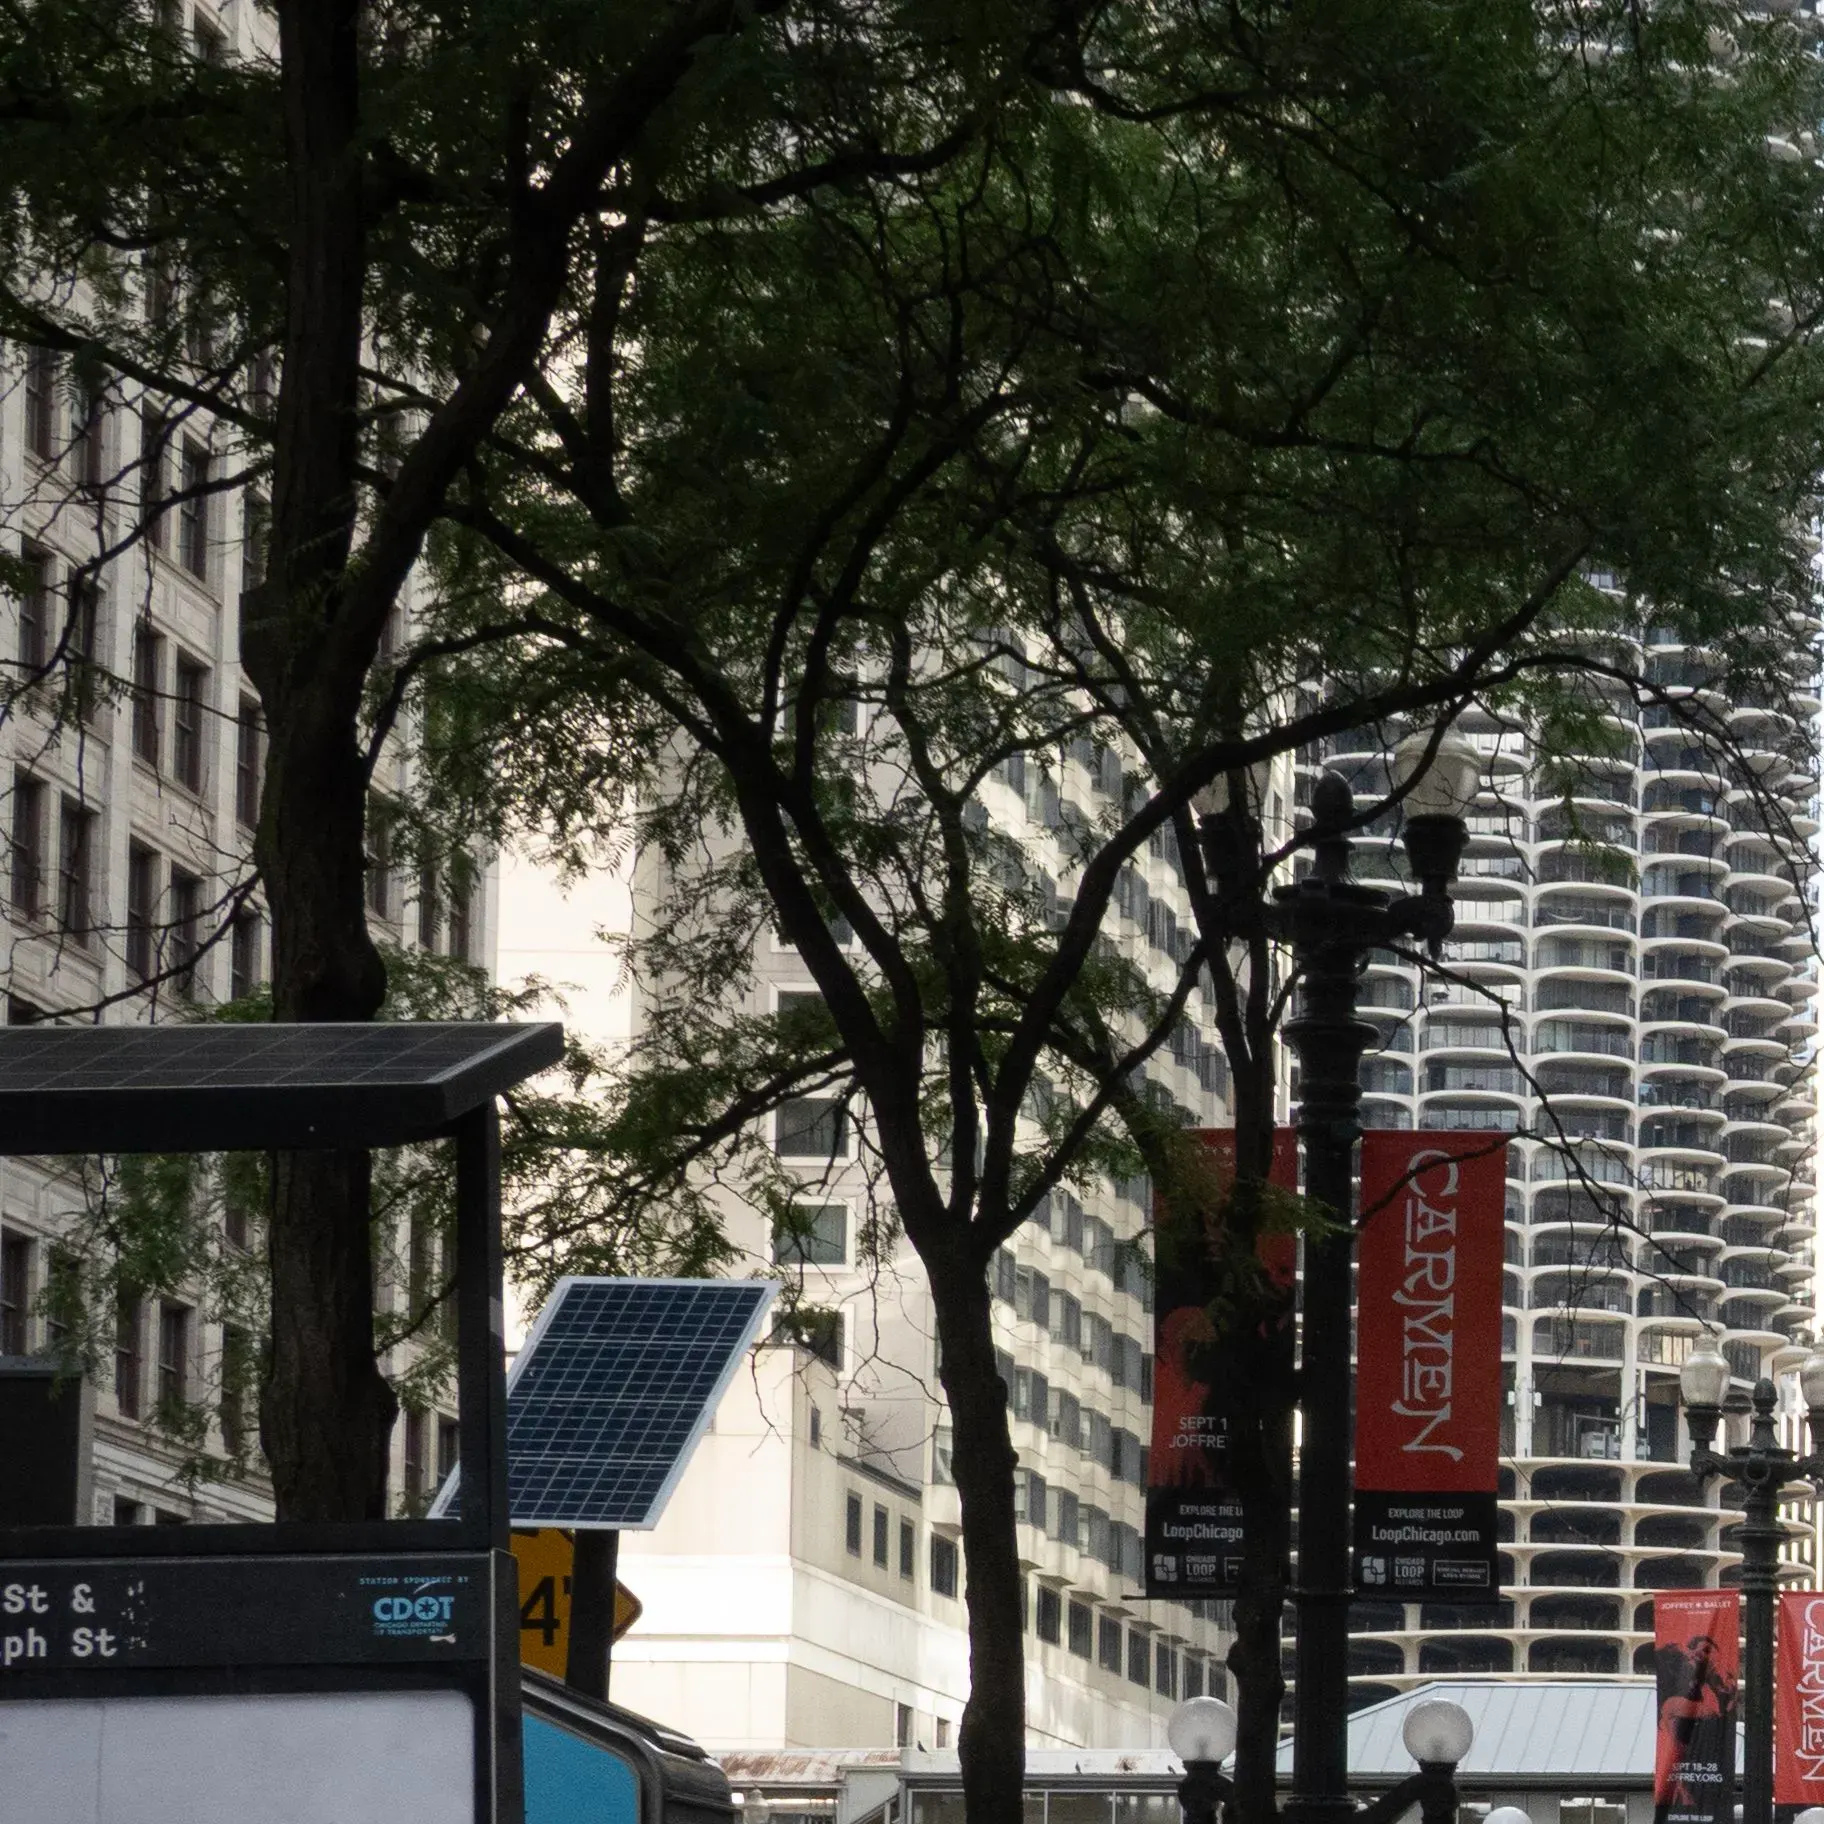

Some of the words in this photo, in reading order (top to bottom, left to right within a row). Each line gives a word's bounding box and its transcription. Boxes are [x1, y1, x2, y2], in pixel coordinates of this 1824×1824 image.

[1391, 1149, 1464, 1462] CARMEN
[1179, 1416, 1215, 1431] SEPT
[1169, 1434, 1229, 1449] JOFFRE
[1179, 1504, 1216, 1517] EXPLORE
[1218, 1505, 1235, 1517] THE
[1388, 1507, 1424, 1519] EXPLORE
[1426, 1508, 1441, 1519] THE
[1443, 1508, 1465, 1519] LOOP
[1372, 1525, 1480, 1546] LoopChicago.com
[1186, 1563, 1216, 1576] LOOP
[1394, 1565, 1425, 1578] LOOP
[3, 1583, 49, 1614] St
[71, 1583, 96, 1613] &
[373, 1595, 456, 1622] CDOT
[0, 1627, 48, 1666] ph
[71, 1626, 118, 1658] St
